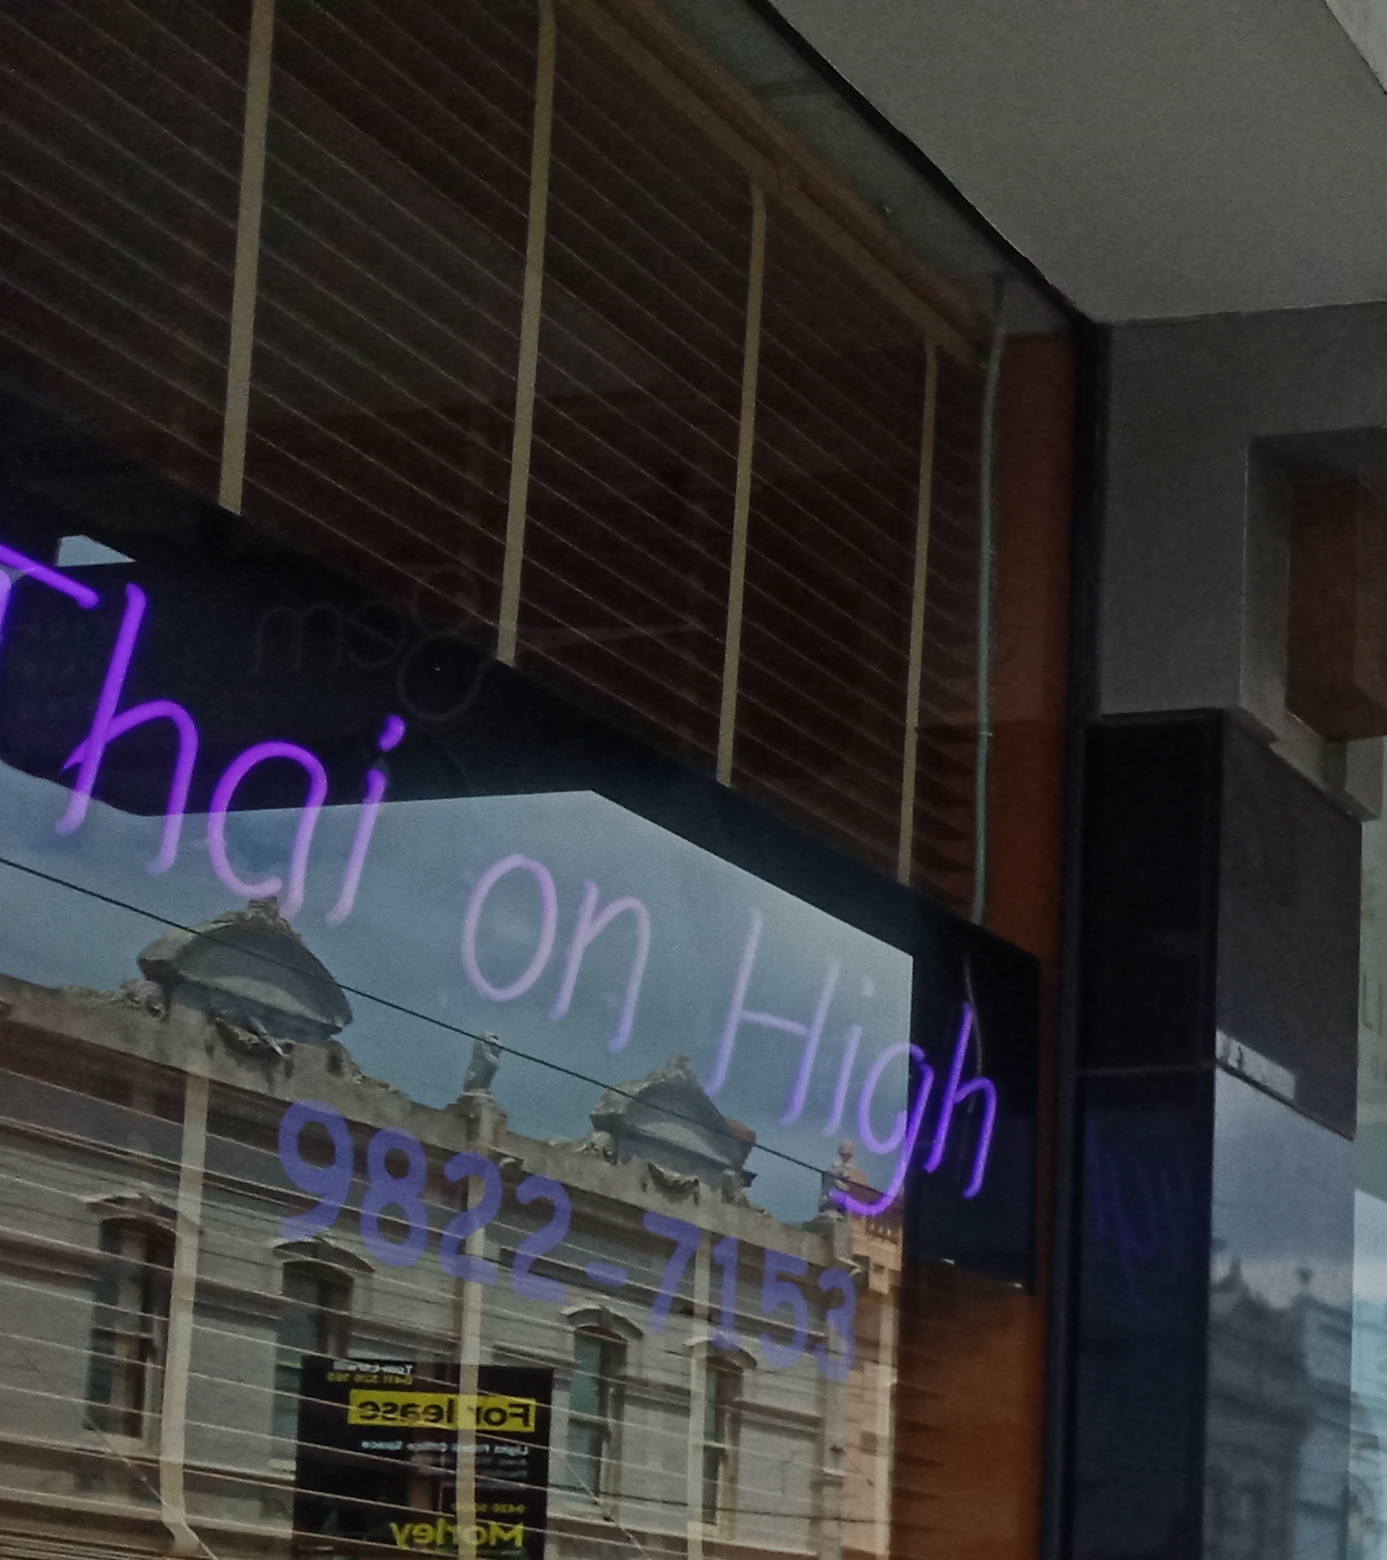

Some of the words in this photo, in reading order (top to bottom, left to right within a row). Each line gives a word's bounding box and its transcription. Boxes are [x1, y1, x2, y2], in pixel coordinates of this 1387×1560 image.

[461, 853, 652, 1052] on
[705, 908, 999, 1216] High
[278, 1099, 858, 1381] 9822-7153
